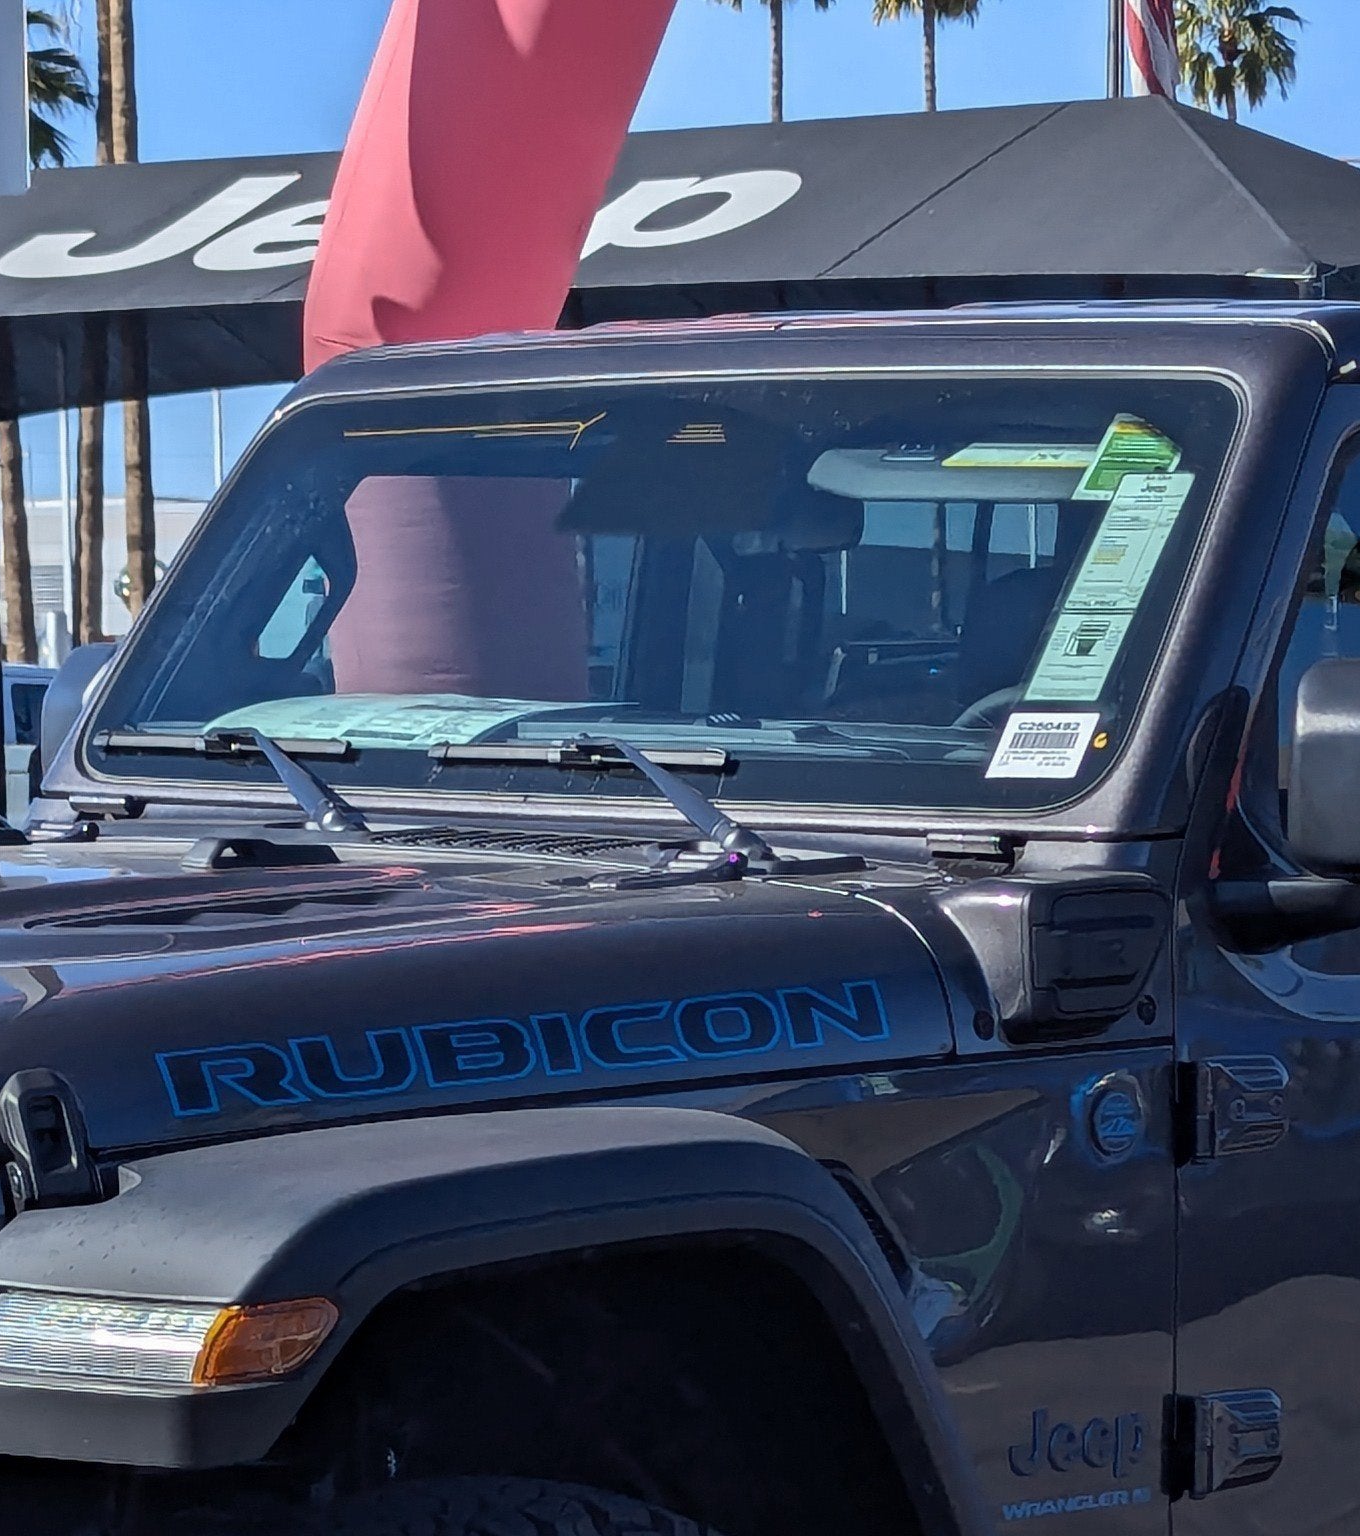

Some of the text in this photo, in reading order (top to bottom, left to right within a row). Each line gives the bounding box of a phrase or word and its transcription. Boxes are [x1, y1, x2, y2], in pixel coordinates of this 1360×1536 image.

[154, 979, 890, 1118] RUBICON
[1008, 1408, 1149, 1478] Jeep
[1001, 1489, 1129, 1520] WRANGLER
